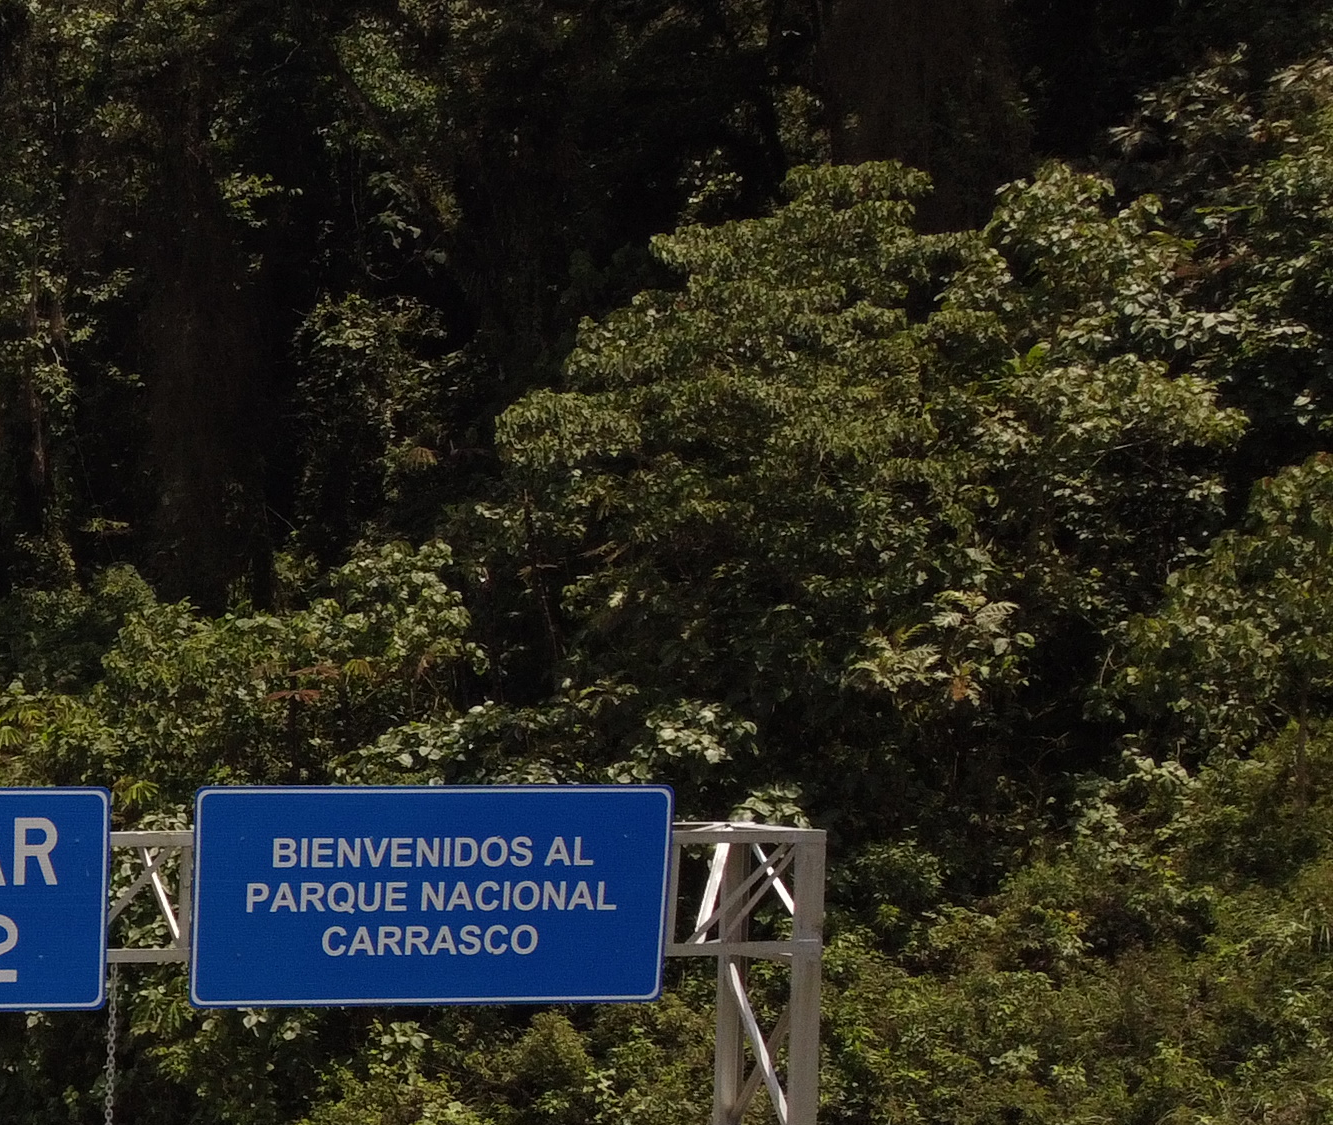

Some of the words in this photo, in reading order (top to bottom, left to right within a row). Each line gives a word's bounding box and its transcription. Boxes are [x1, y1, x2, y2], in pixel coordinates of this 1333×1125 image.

[273, 836, 533, 868] BIENVENIDOS
[545, 836, 593, 866] AL
[245, 881, 408, 914] PARQUE
[421, 880, 617, 911] NACIONAL
[321, 924, 538, 957] CARRASCO
